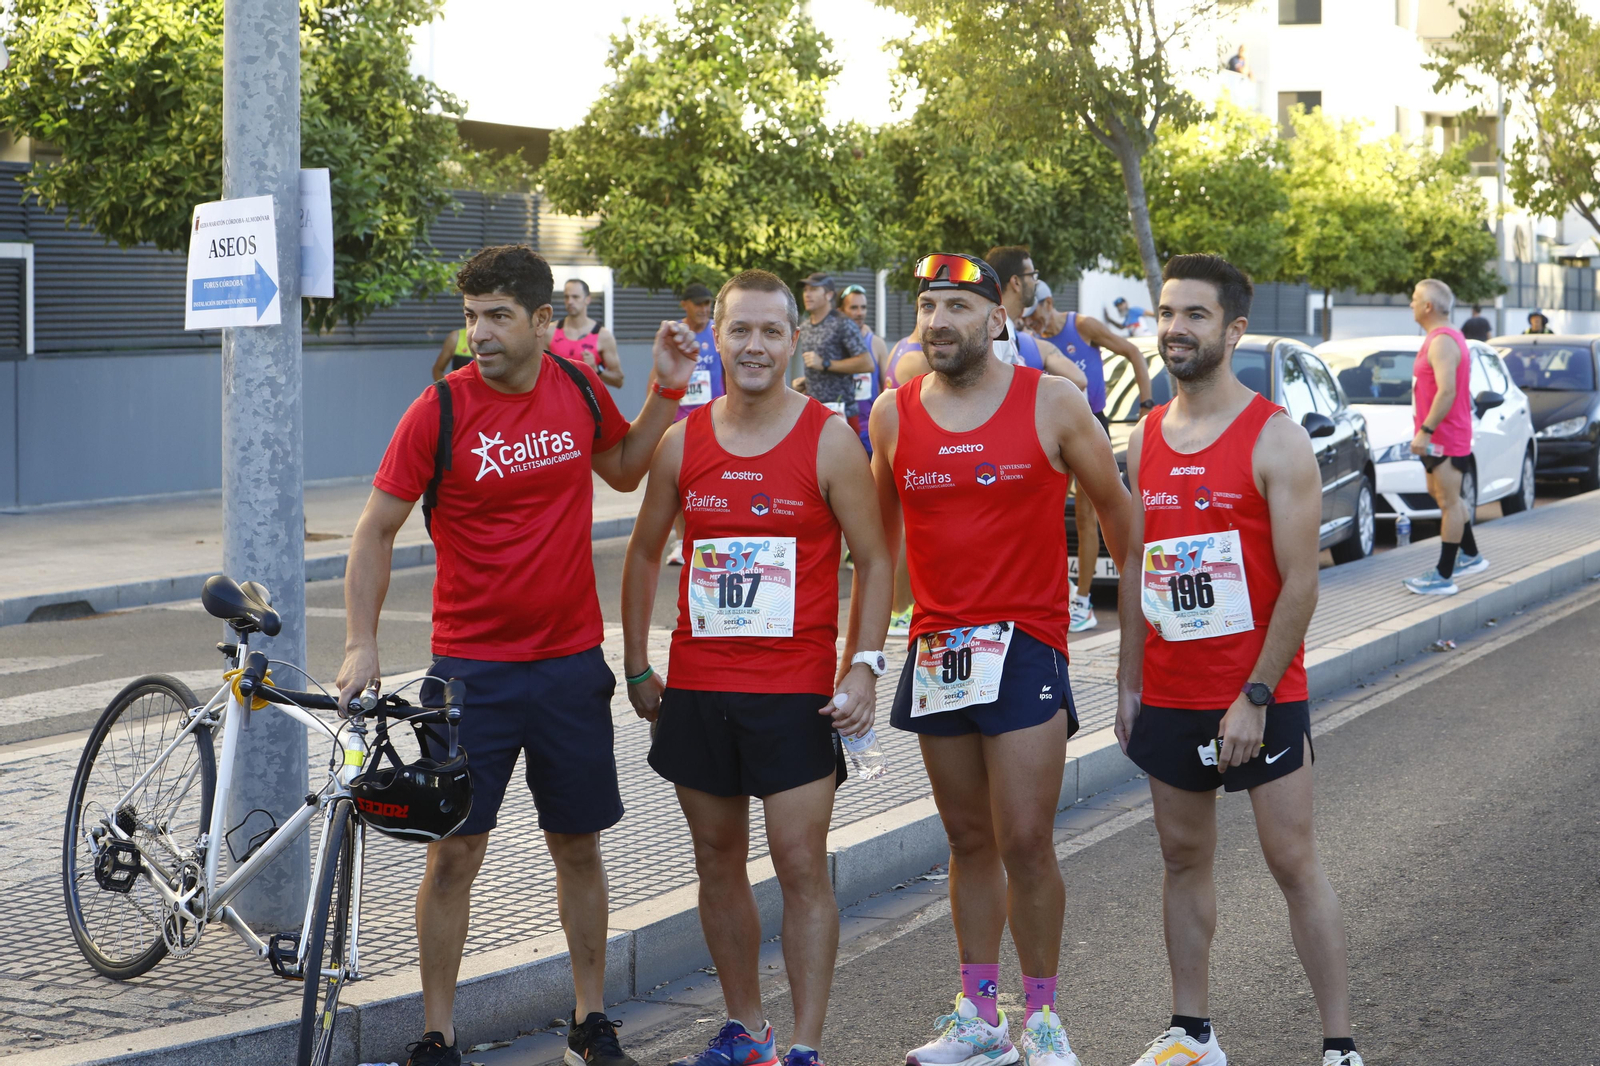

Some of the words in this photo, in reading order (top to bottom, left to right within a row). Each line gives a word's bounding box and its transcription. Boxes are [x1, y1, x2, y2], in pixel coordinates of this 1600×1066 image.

[208, 235, 257, 259] ASEOS
[203, 281, 219, 289] FORUS
[219, 279, 244, 288] CÓRDOBA
[499, 430, 575, 466] califas
[913, 472, 952, 486] califas
[692, 495, 728, 508] califas
[773, 498, 804, 506] UNIVERSIDAD
[1145, 492, 1179, 506] califas
[773, 508, 795, 516] CÓRDOBA
[717, 573, 761, 608] 167
[1168, 572, 1215, 612] 196
[942, 647, 972, 683] 90
[356, 796, 410, 818] ROCES
